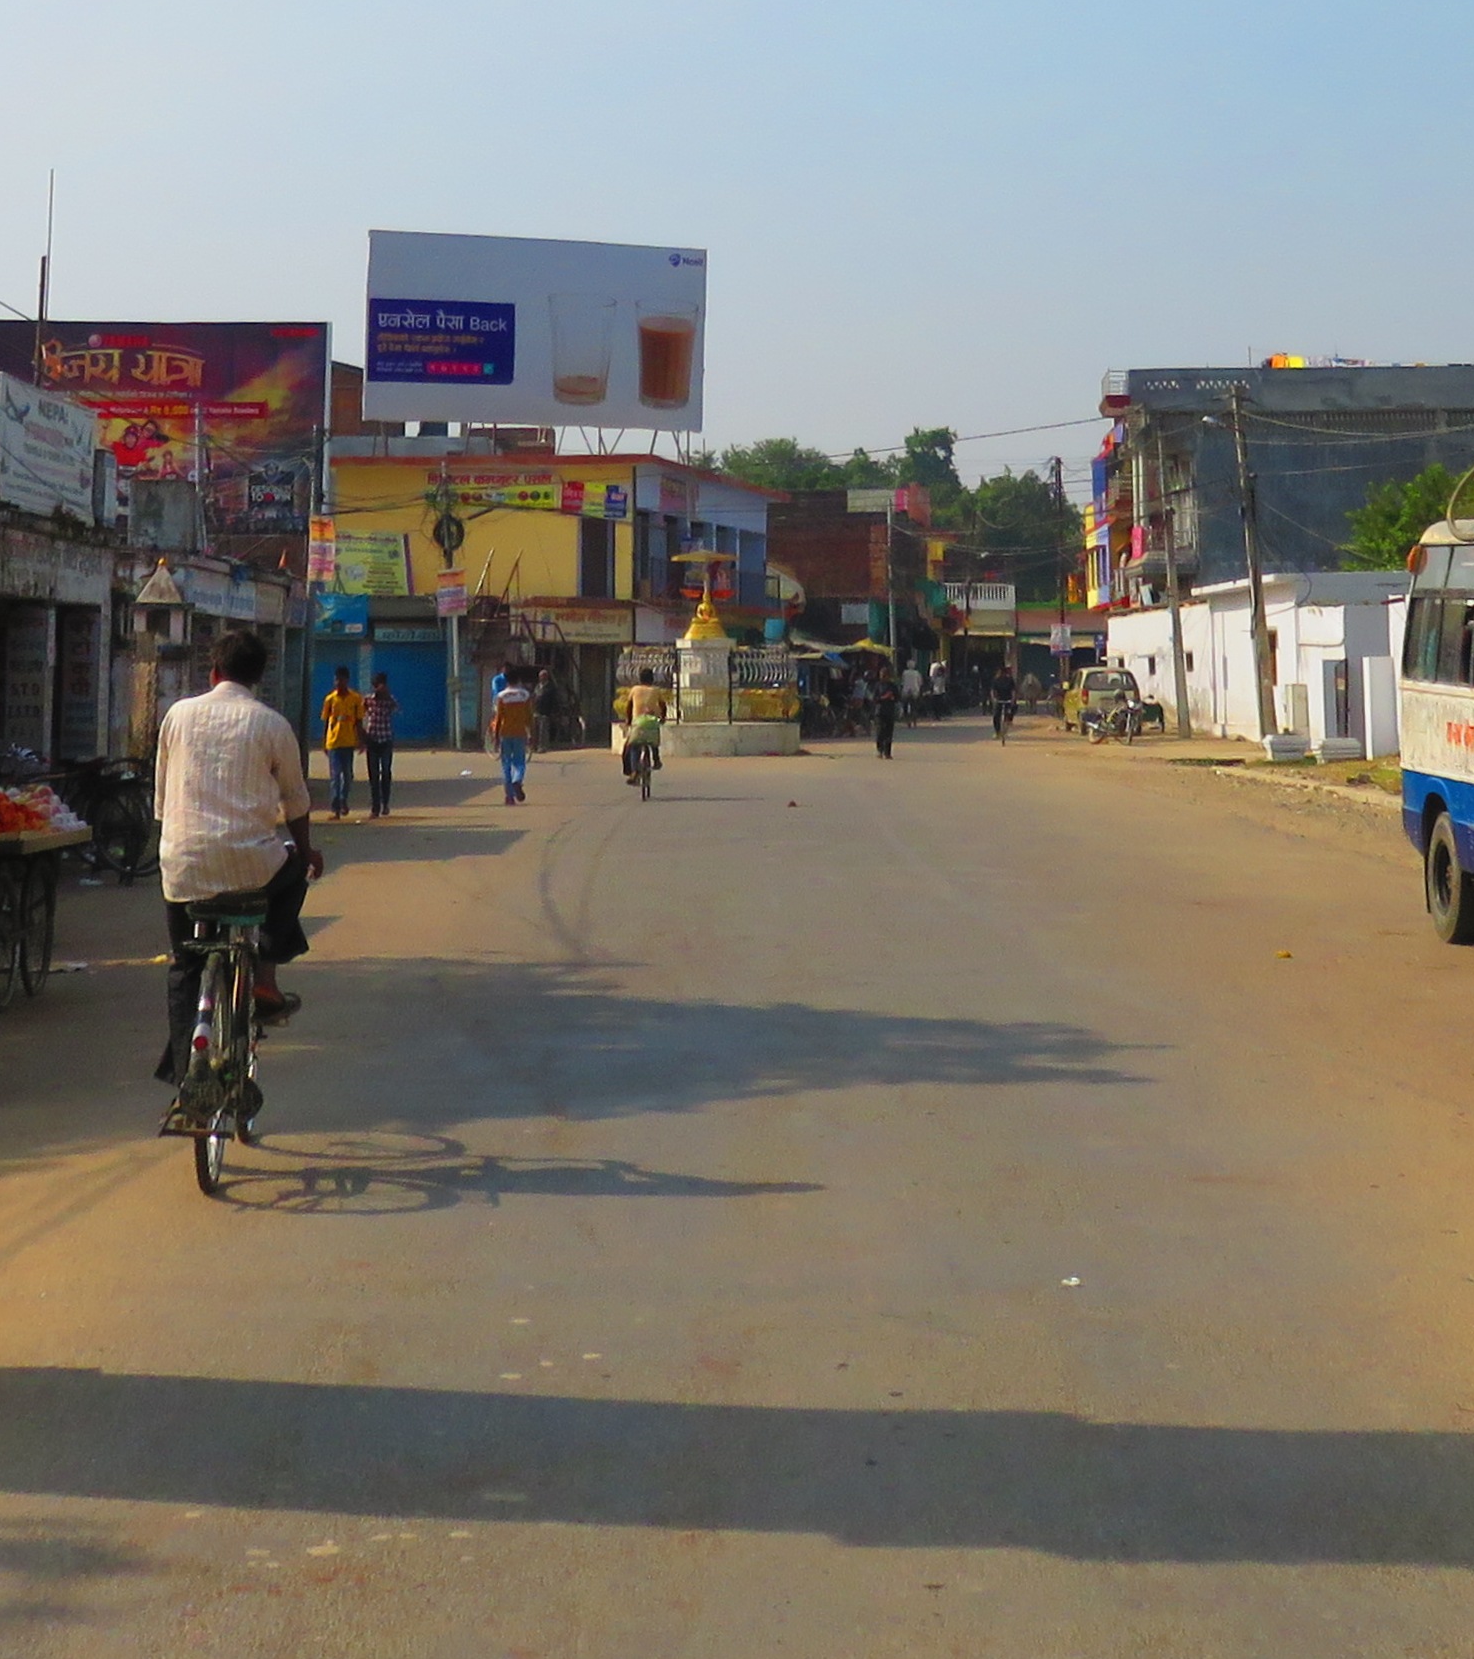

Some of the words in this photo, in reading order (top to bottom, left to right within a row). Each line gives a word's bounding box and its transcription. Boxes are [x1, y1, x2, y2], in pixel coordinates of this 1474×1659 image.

[377, 309, 431, 329] एनसेल
[436, 309, 464, 330] पैसा
[470, 317, 508, 332] Back
[131, 348, 205, 389] यात्रा
